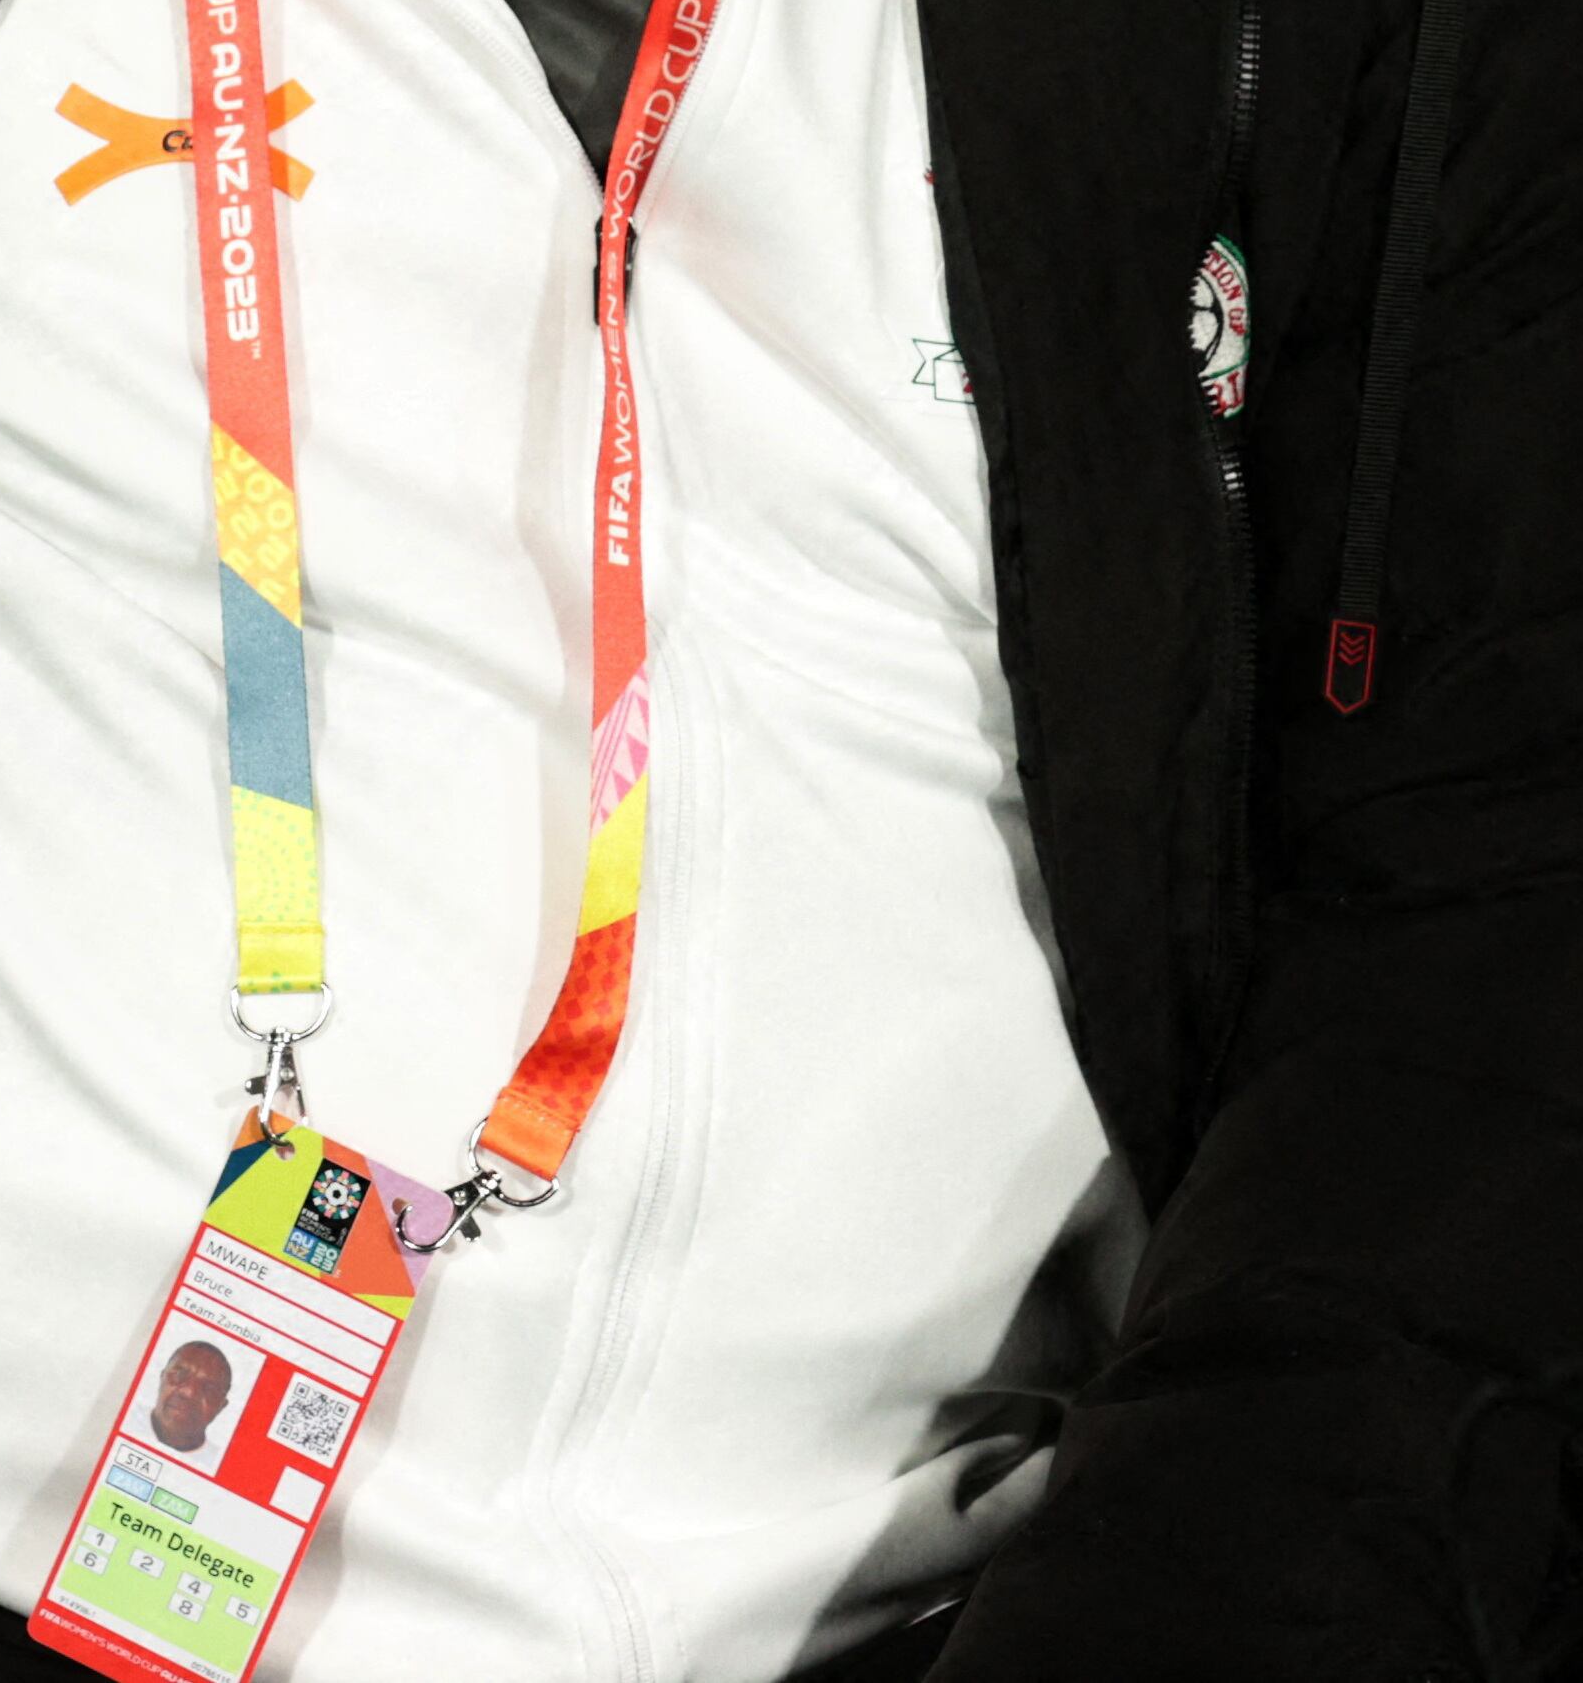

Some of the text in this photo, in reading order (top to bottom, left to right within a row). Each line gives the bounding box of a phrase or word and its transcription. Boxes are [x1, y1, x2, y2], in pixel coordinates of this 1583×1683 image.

[608, 89, 676, 238] WORLD
[607, 471, 632, 566] FIFA
[290, 1231, 315, 1248] AU
[206, 1240, 270, 1281] MWAPE
[193, 1270, 234, 1298] Bruce
[183, 1296, 261, 1344] Team Zambia
[125, 1453, 151, 1474] STA
[109, 1502, 255, 1589] Team Delegate
[83, 1552, 98, 1568] 6
[139, 1555, 155, 1572] 2
[188, 1580, 202, 1595] 4
[178, 1599, 194, 1616] 8
[236, 1603, 251, 1620] 5
